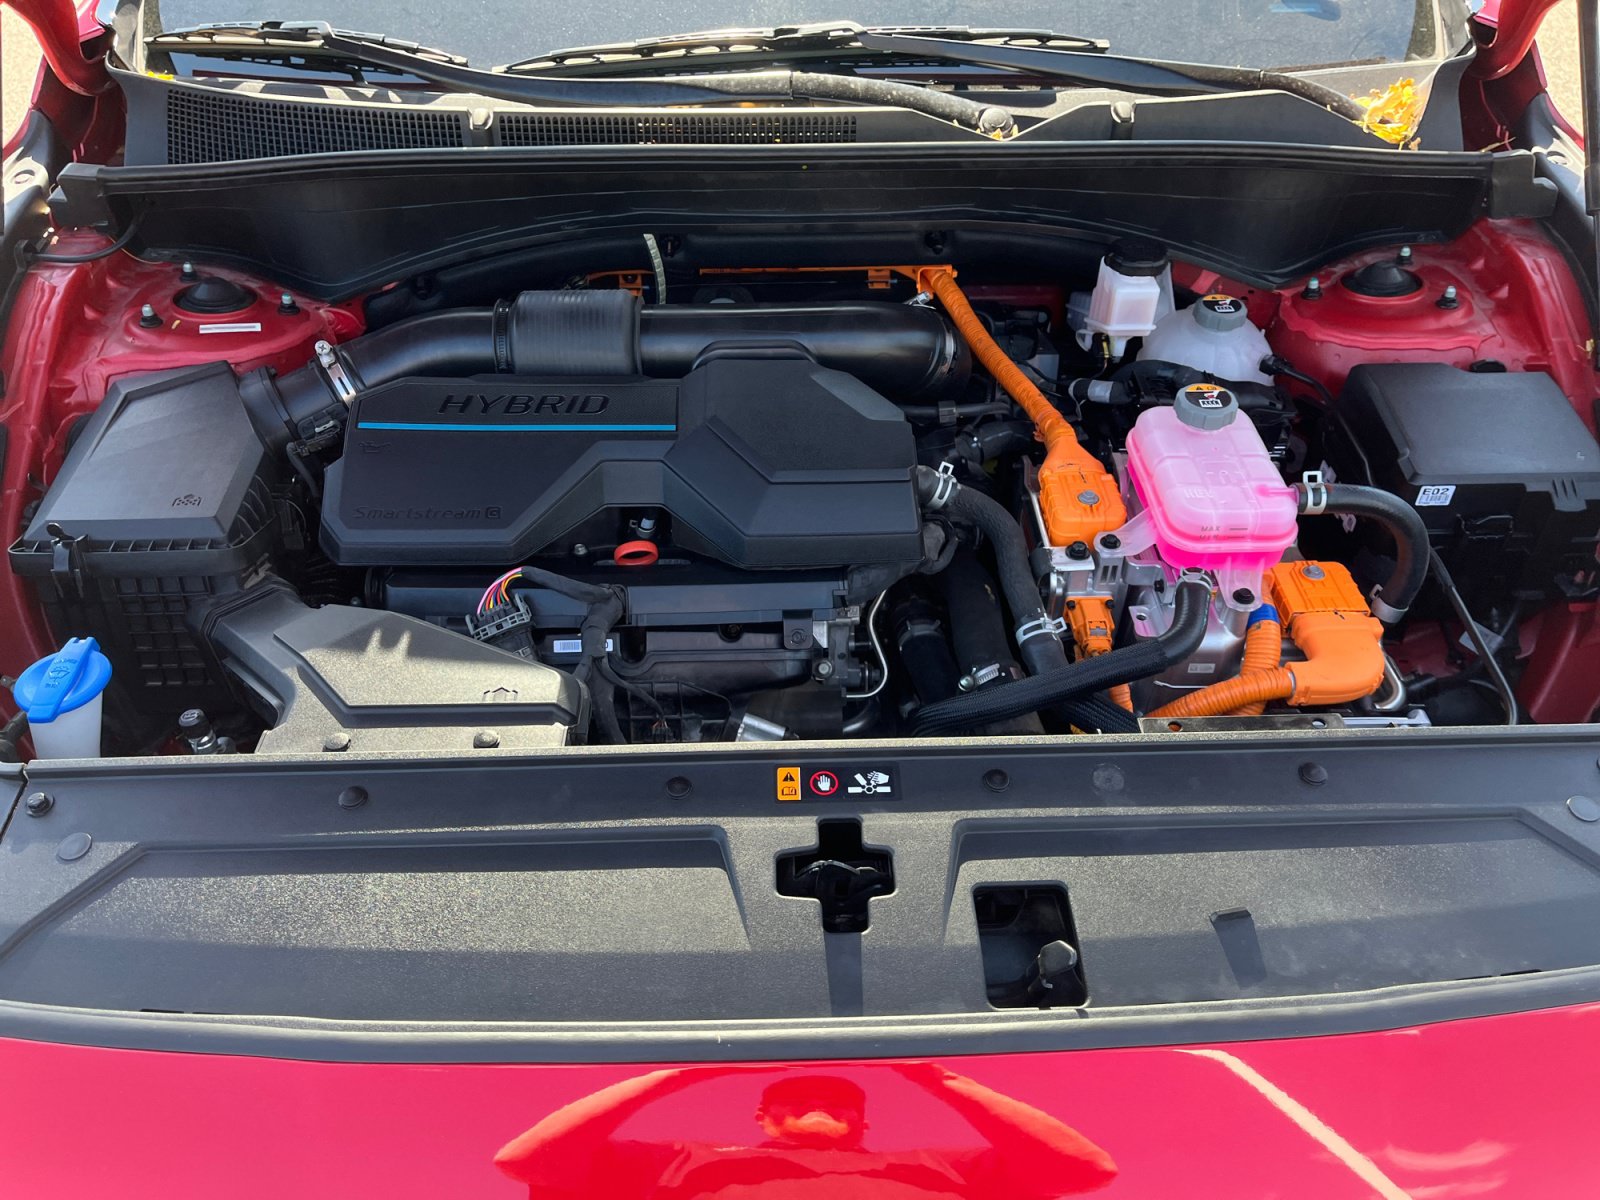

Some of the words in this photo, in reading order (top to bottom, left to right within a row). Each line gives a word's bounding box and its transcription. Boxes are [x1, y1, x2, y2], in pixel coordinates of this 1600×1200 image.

[437, 394, 610, 415] HYBRID
[1422, 487, 1450, 496] E02
[352, 506, 481, 520] Smartstream
